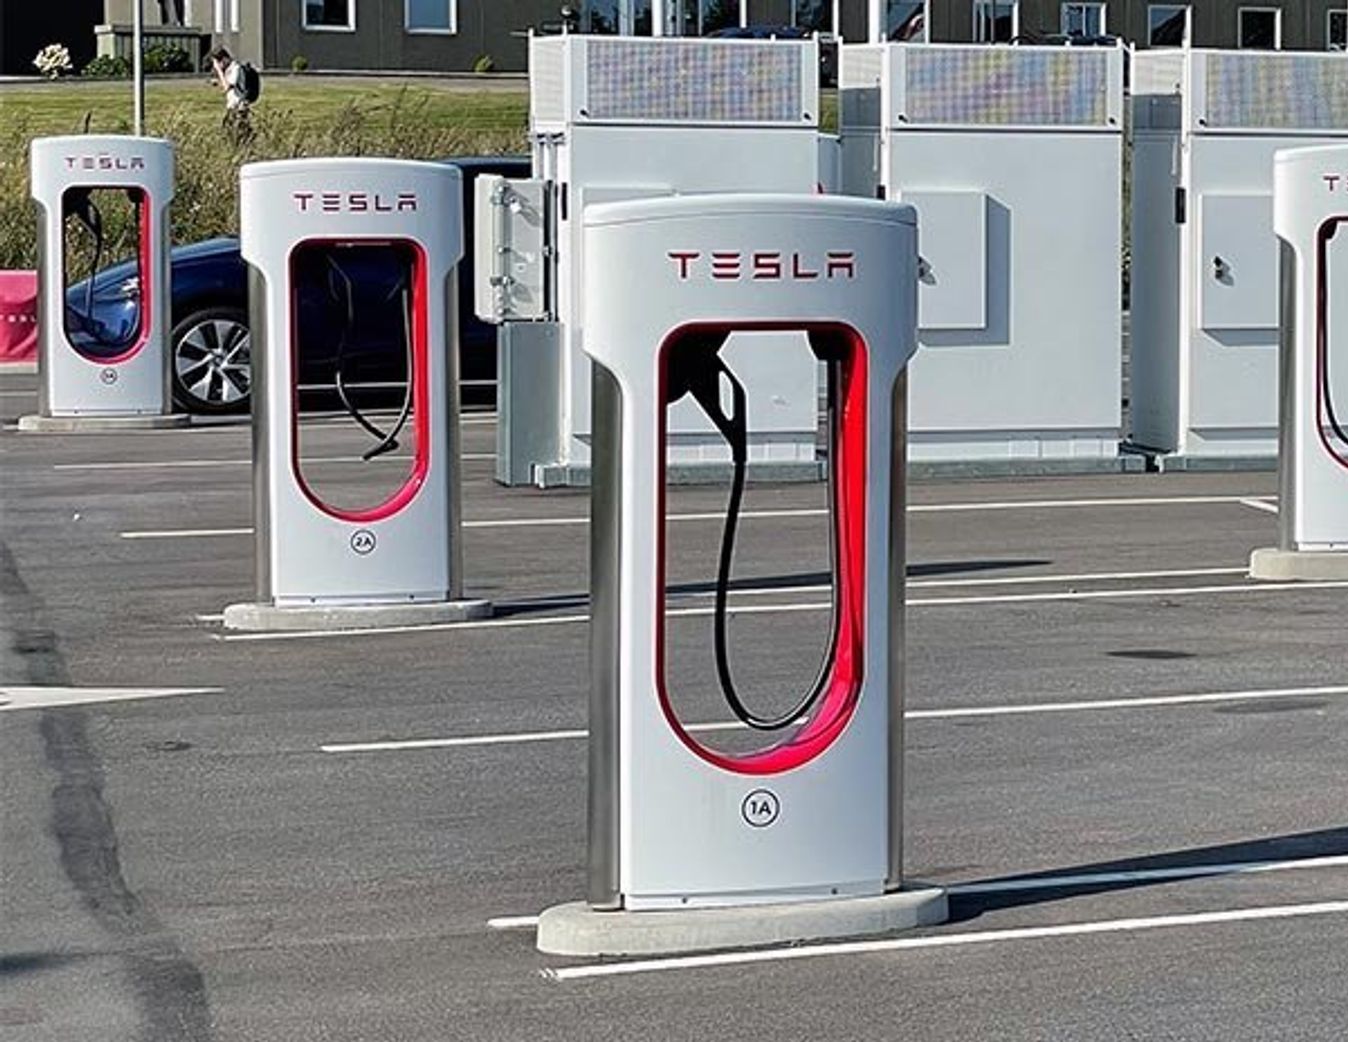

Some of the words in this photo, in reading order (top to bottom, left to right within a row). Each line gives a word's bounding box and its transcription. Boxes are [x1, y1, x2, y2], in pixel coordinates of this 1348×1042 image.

[64, 157, 144, 169] TESLA
[294, 194, 417, 211] TESLA
[668, 253, 854, 279] TESLA
[356, 536, 371, 546] 2A
[750, 801, 771, 815] 1A
